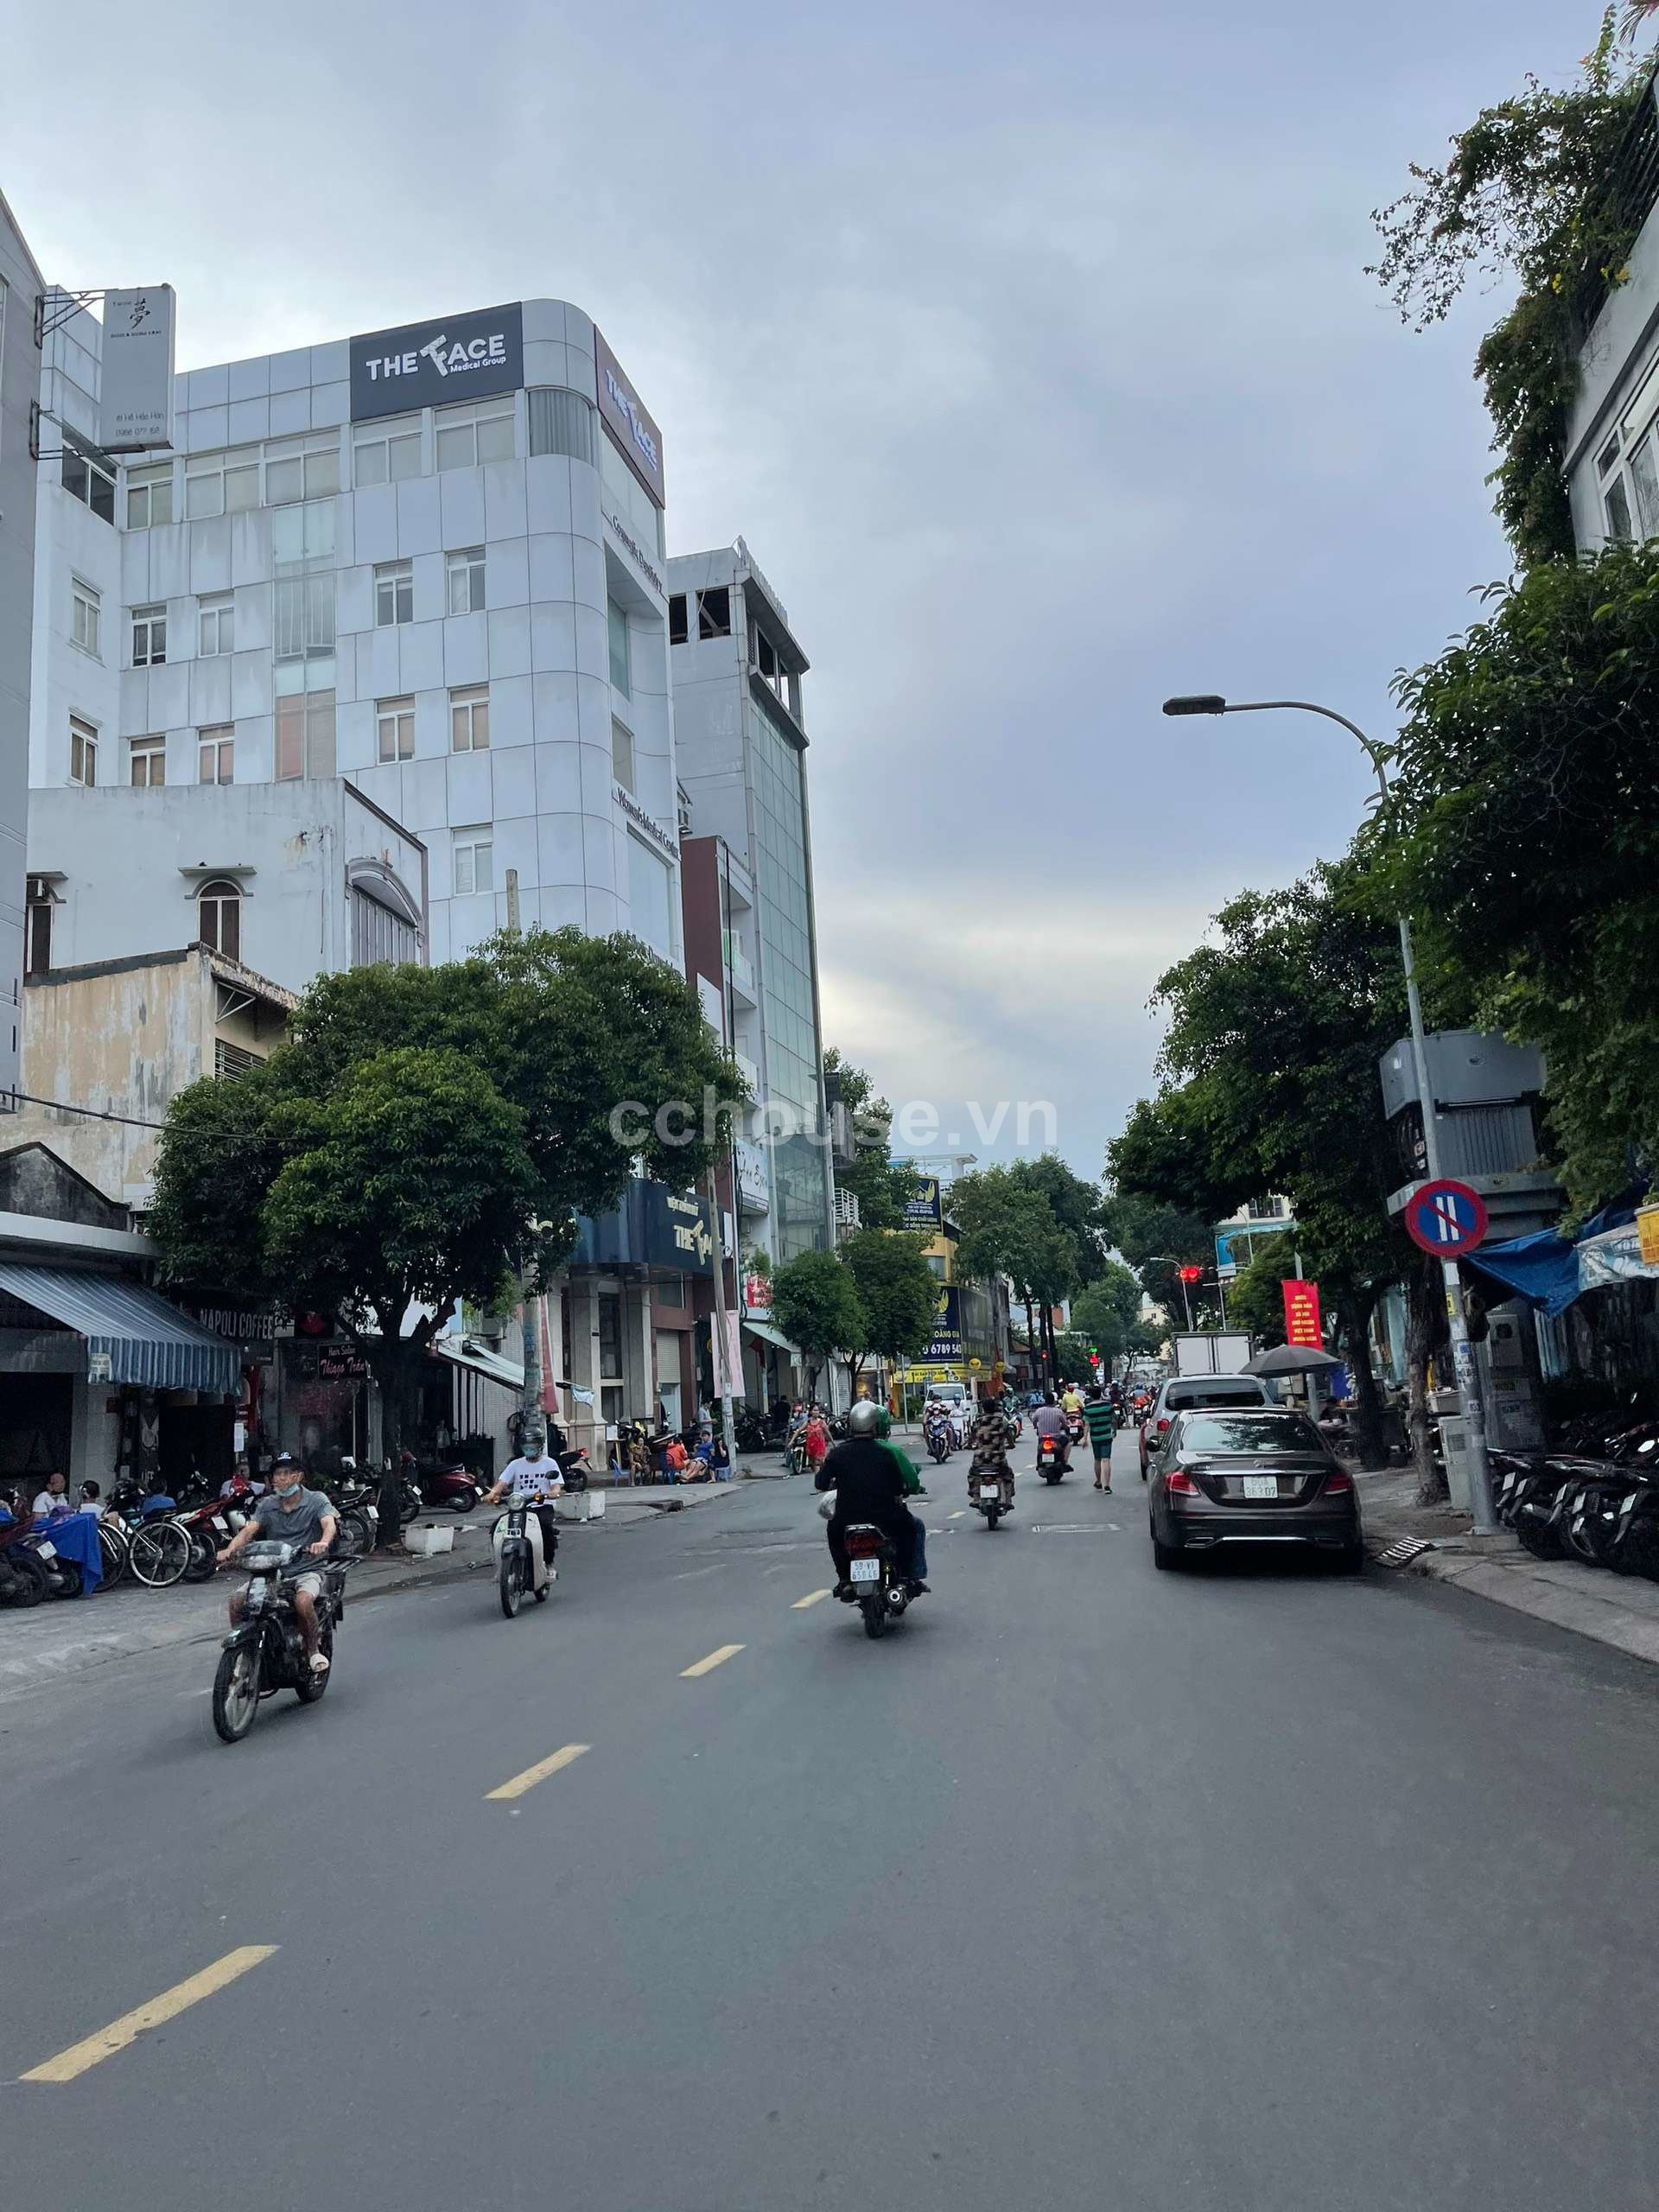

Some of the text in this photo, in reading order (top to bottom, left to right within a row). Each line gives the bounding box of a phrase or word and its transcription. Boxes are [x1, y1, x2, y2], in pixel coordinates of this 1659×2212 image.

[365, 334, 505, 381] THE FACE
[449, 355, 506, 373] Medical Group
[673, 1224, 695, 1251] THE
[200, 1307, 274, 1340] NAPOLI COFFEE
[931, 1344, 950, 1355] 6789
